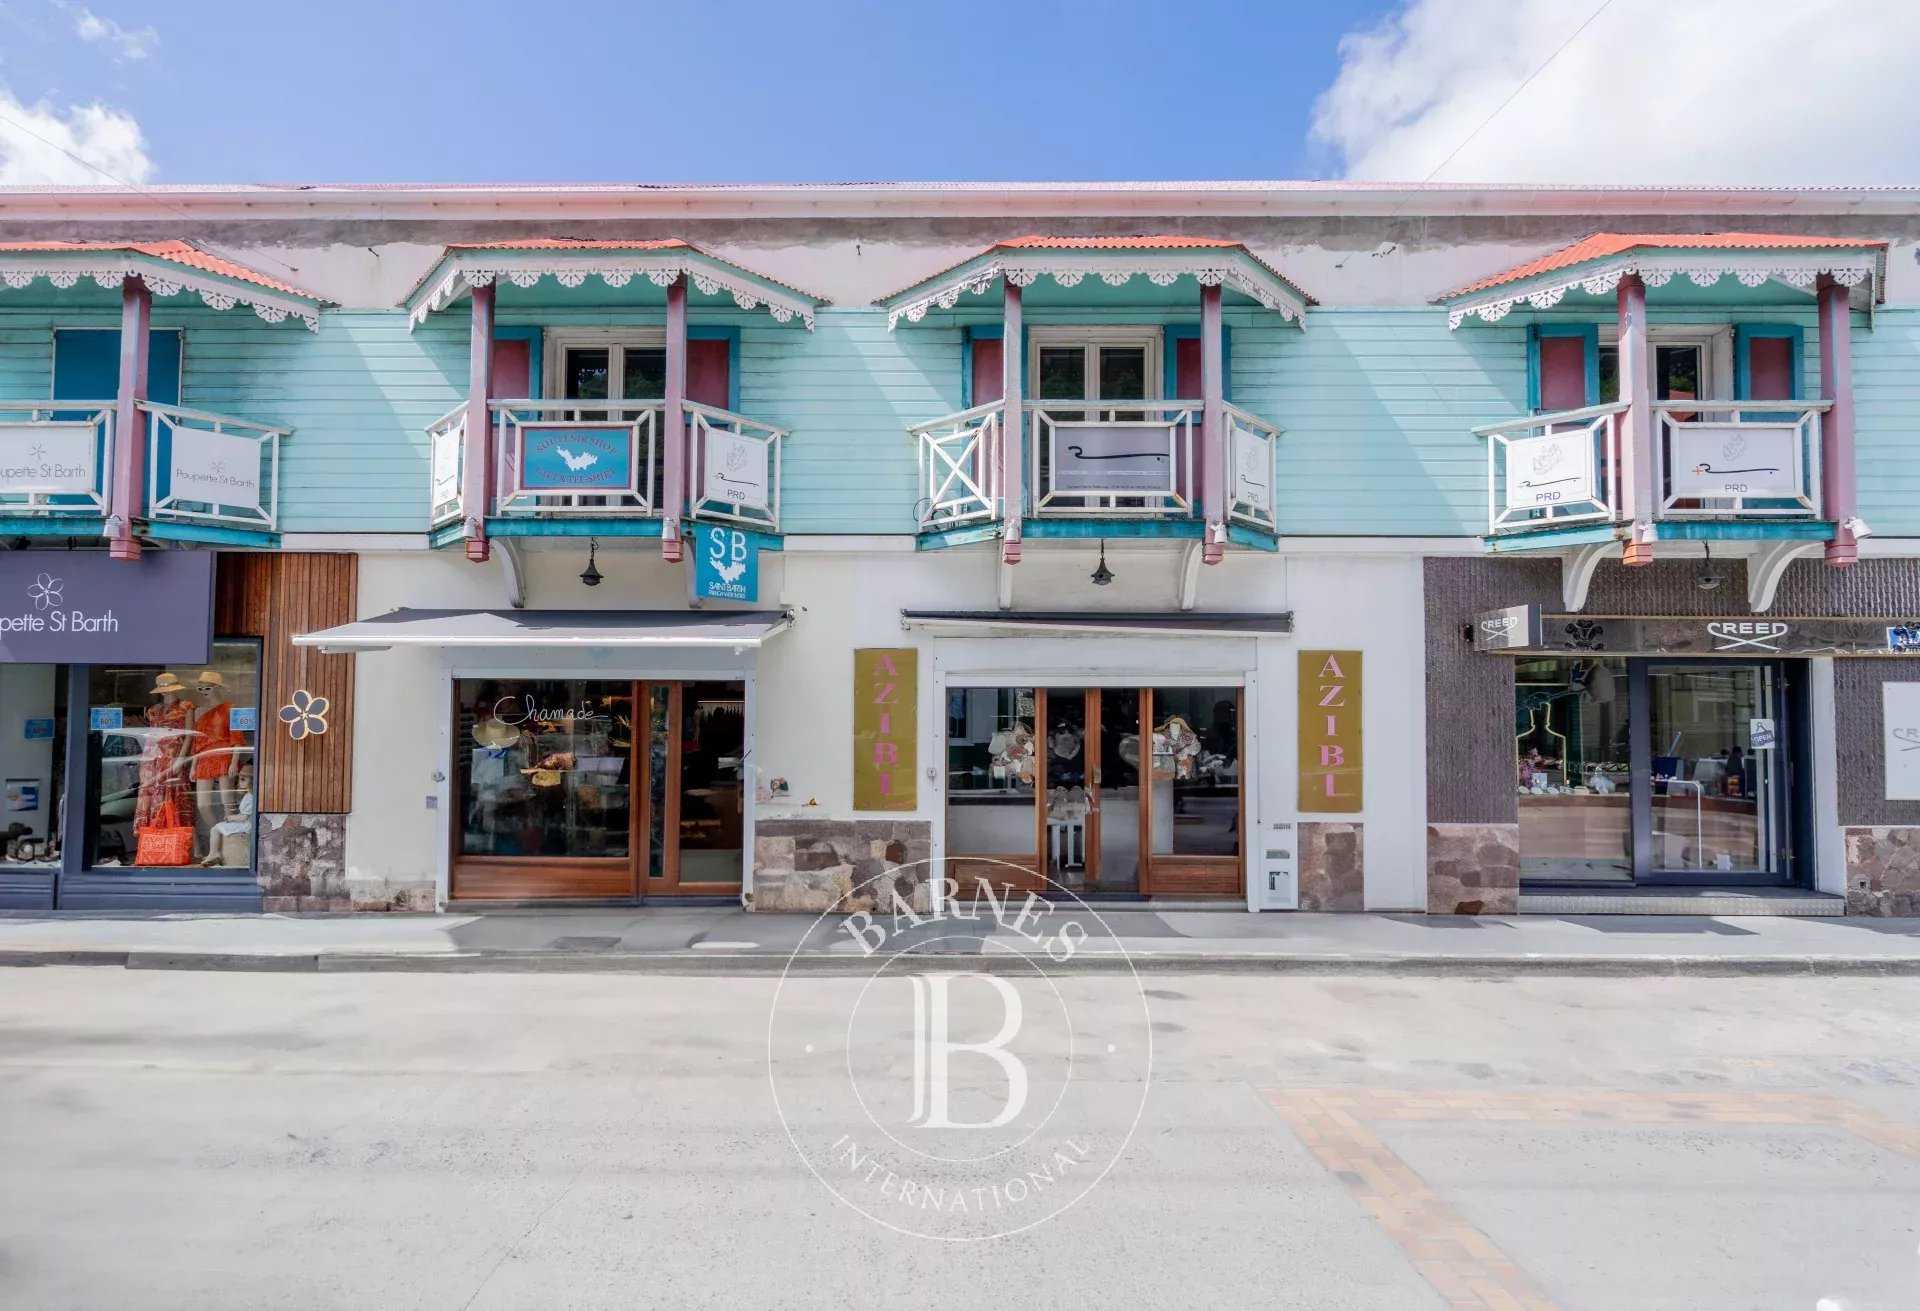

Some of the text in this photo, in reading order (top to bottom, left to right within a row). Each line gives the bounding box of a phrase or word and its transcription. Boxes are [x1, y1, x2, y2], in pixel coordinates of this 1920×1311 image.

[40, 463, 51, 478] St
[55, 463, 86, 478] Barth
[727, 489, 745, 500] PRD
[1535, 491, 1561, 502] PRD
[1724, 483, 1748, 493] PRD
[709, 527, 747, 561] SB
[0, 609, 119, 640] pette St Barth
[1481, 616, 1518, 637] CREED
[1706, 622, 1788, 643] CREED
[493, 695, 608, 725] Chamade
